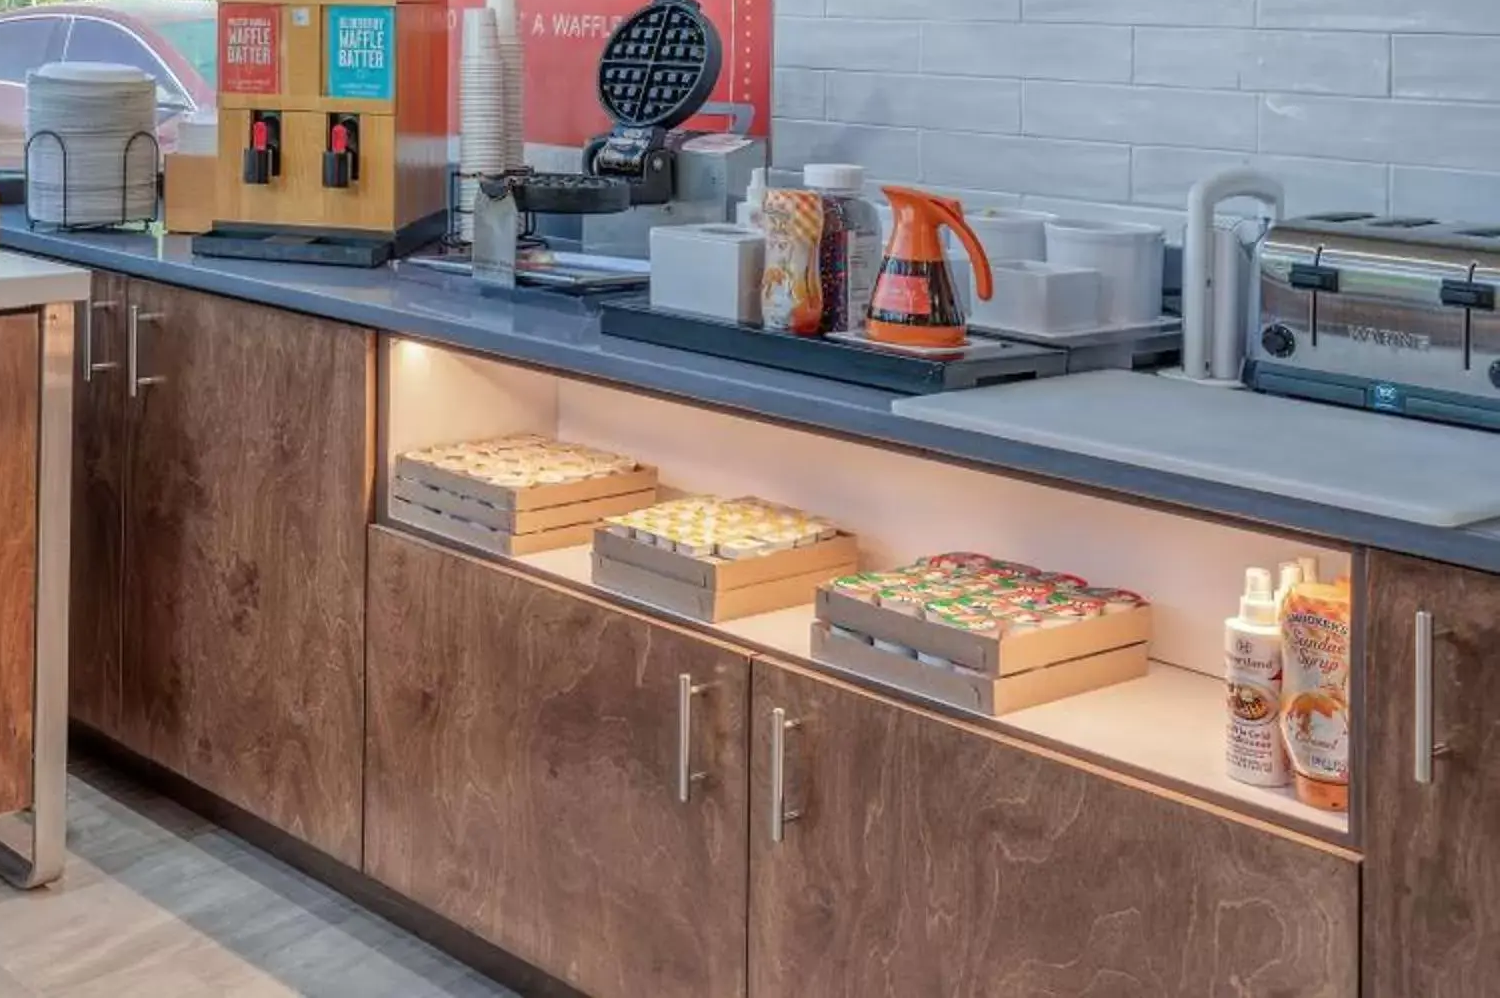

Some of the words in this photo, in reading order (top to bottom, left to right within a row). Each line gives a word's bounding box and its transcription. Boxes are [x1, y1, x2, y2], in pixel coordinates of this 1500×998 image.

[227, 26, 271, 45] WAFFLE
[339, 29, 385, 49] WAFFLE
[227, 45, 271, 65] BATTER
[338, 49, 384, 69] BATTER
[1298, 648, 1338, 674] Syrup
